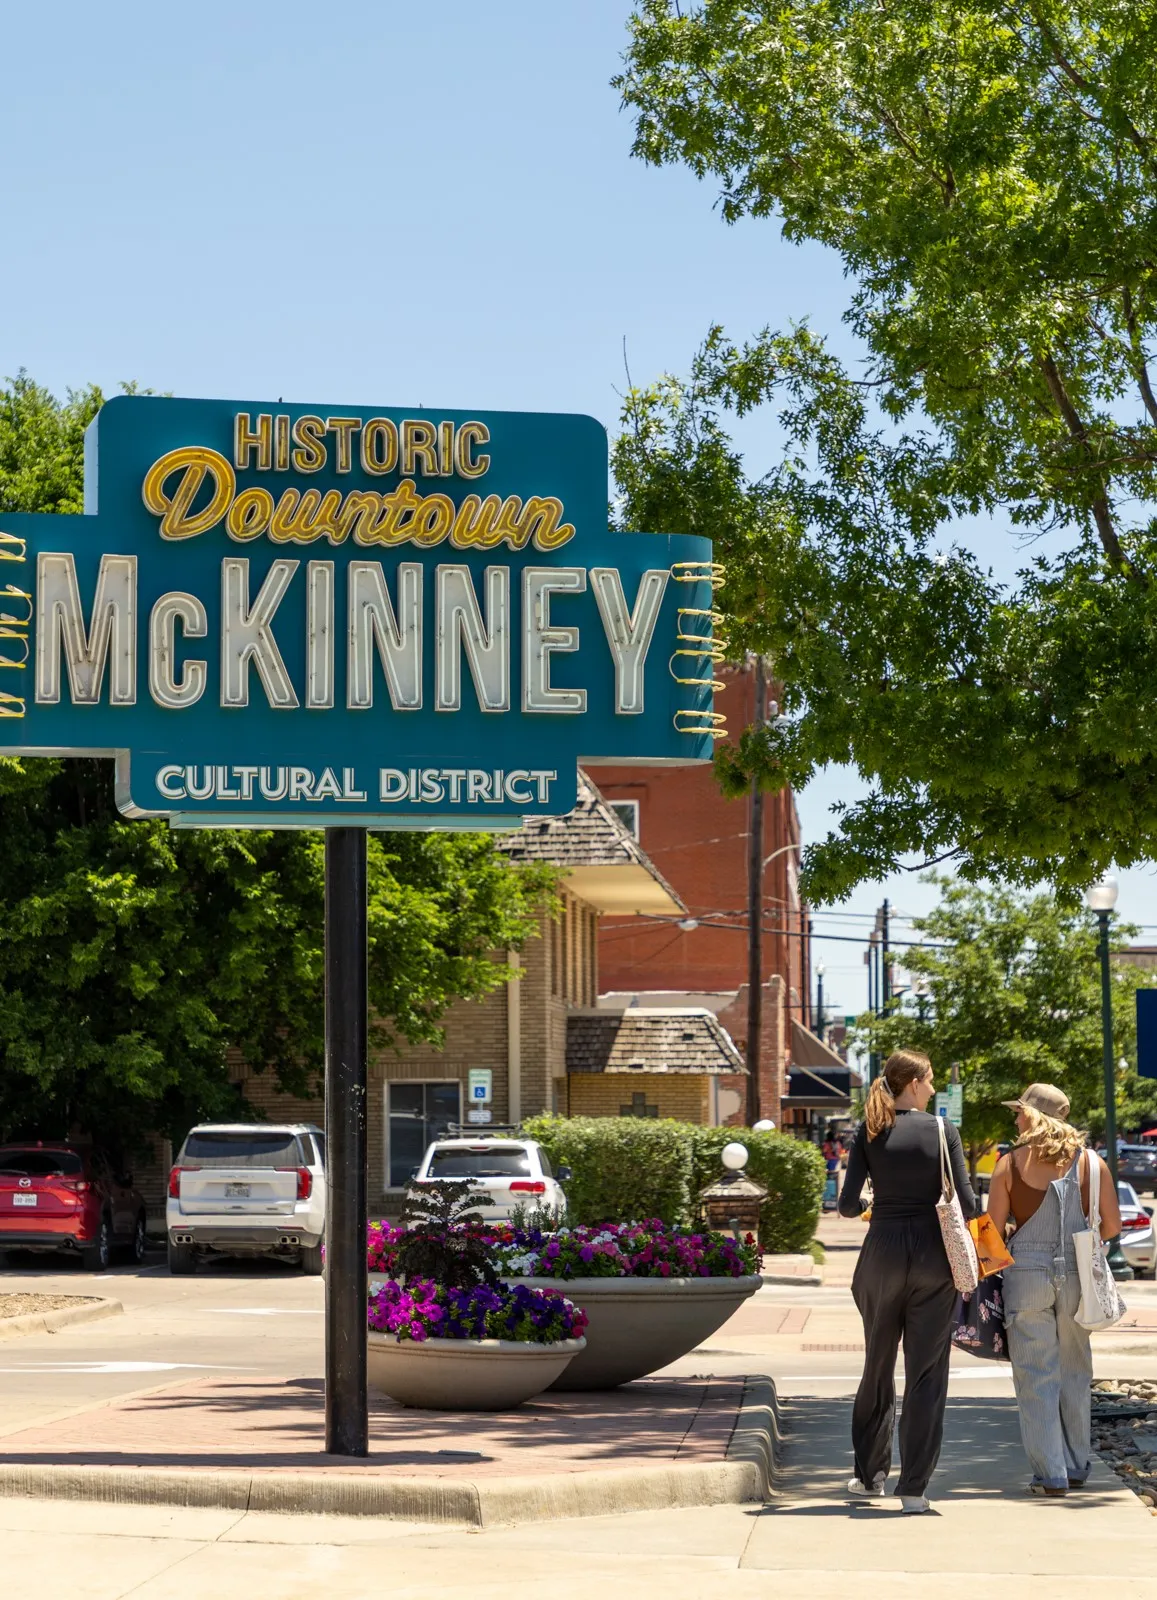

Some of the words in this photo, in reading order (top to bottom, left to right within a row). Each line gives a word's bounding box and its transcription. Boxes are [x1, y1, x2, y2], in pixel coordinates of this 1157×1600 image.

[234, 412, 491, 480] HISTORIC
[142, 446, 576, 552] Downtown
[35, 551, 670, 714] McKINNEY
[155, 764, 367, 802] CULTURAL
[379, 767, 557, 804] DISTRICT
